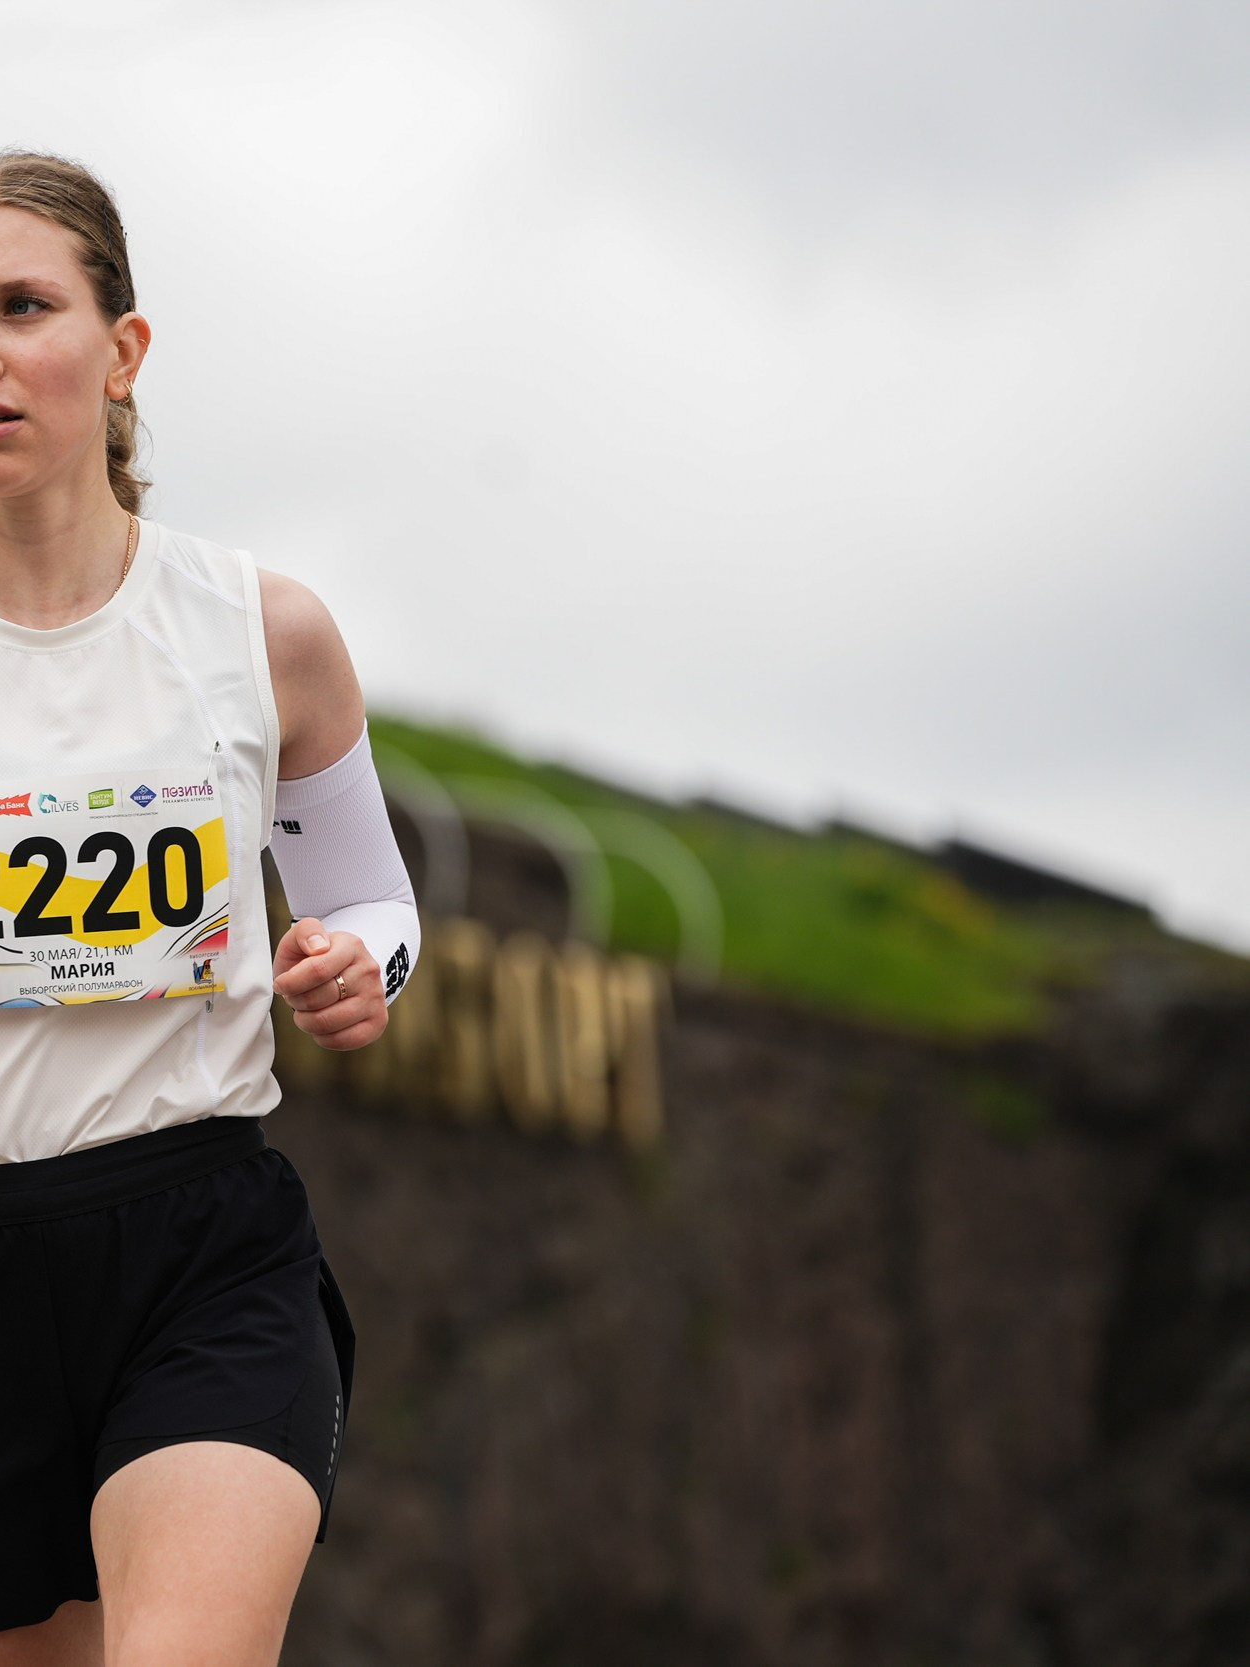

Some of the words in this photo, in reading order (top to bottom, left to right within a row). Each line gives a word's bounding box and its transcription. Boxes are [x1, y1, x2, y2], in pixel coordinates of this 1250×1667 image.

[161, 785, 214, 798] ПОЗИТИВ
[51, 801, 79, 813] ILVES
[30, 951, 45, 962] 30
[85, 946, 109, 959] 21,1
[114, 944, 133, 956] КМ
[51, 961, 115, 980] МАРИЯ
[19, 983, 76, 996] ВЫБОРГСКИЙ
[78, 979, 143, 992] ПОЛУМАРАФОН
